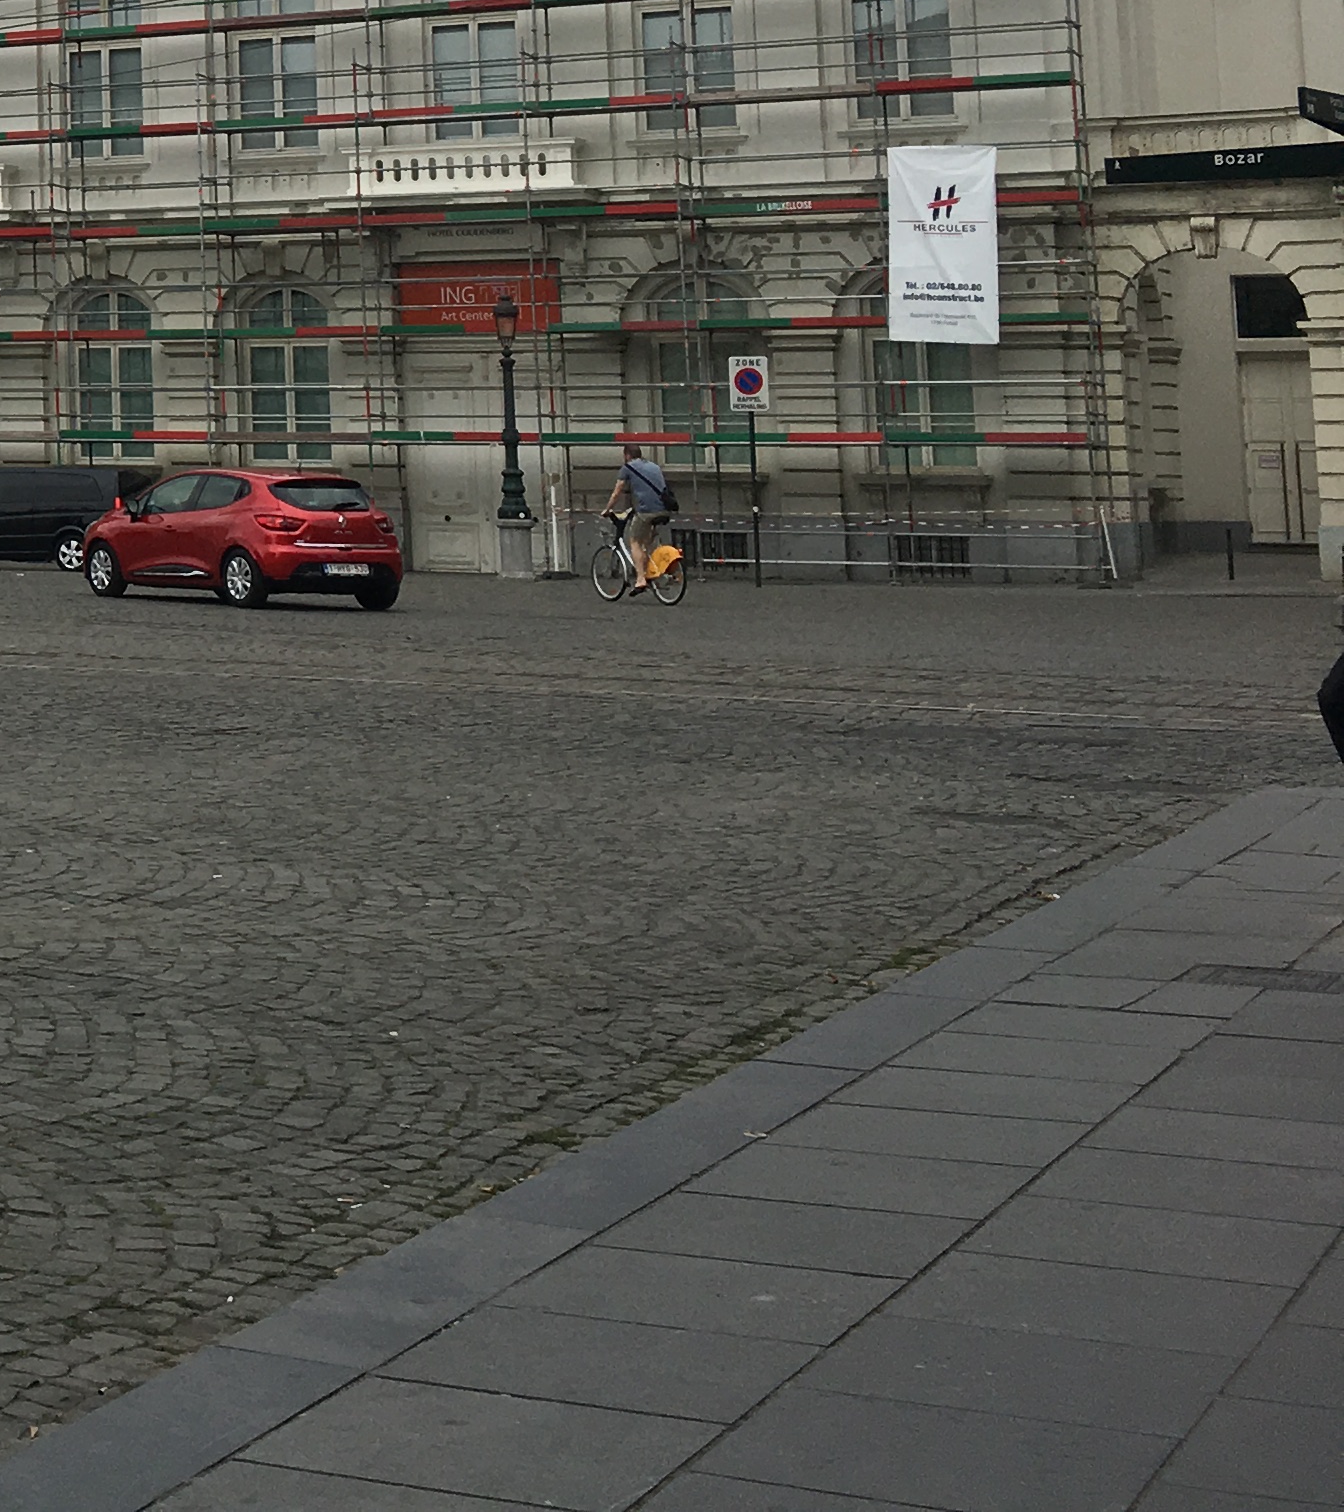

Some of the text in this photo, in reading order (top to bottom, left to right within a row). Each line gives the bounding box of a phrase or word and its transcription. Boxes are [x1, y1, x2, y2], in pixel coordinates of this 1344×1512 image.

[1214, 152, 1265, 167] Bozar
[913, 224, 977, 233] HERCULES
[441, 287, 476, 304] ING
[441, 310, 495, 322] Art Center
[735, 358, 761, 367] ZONE
